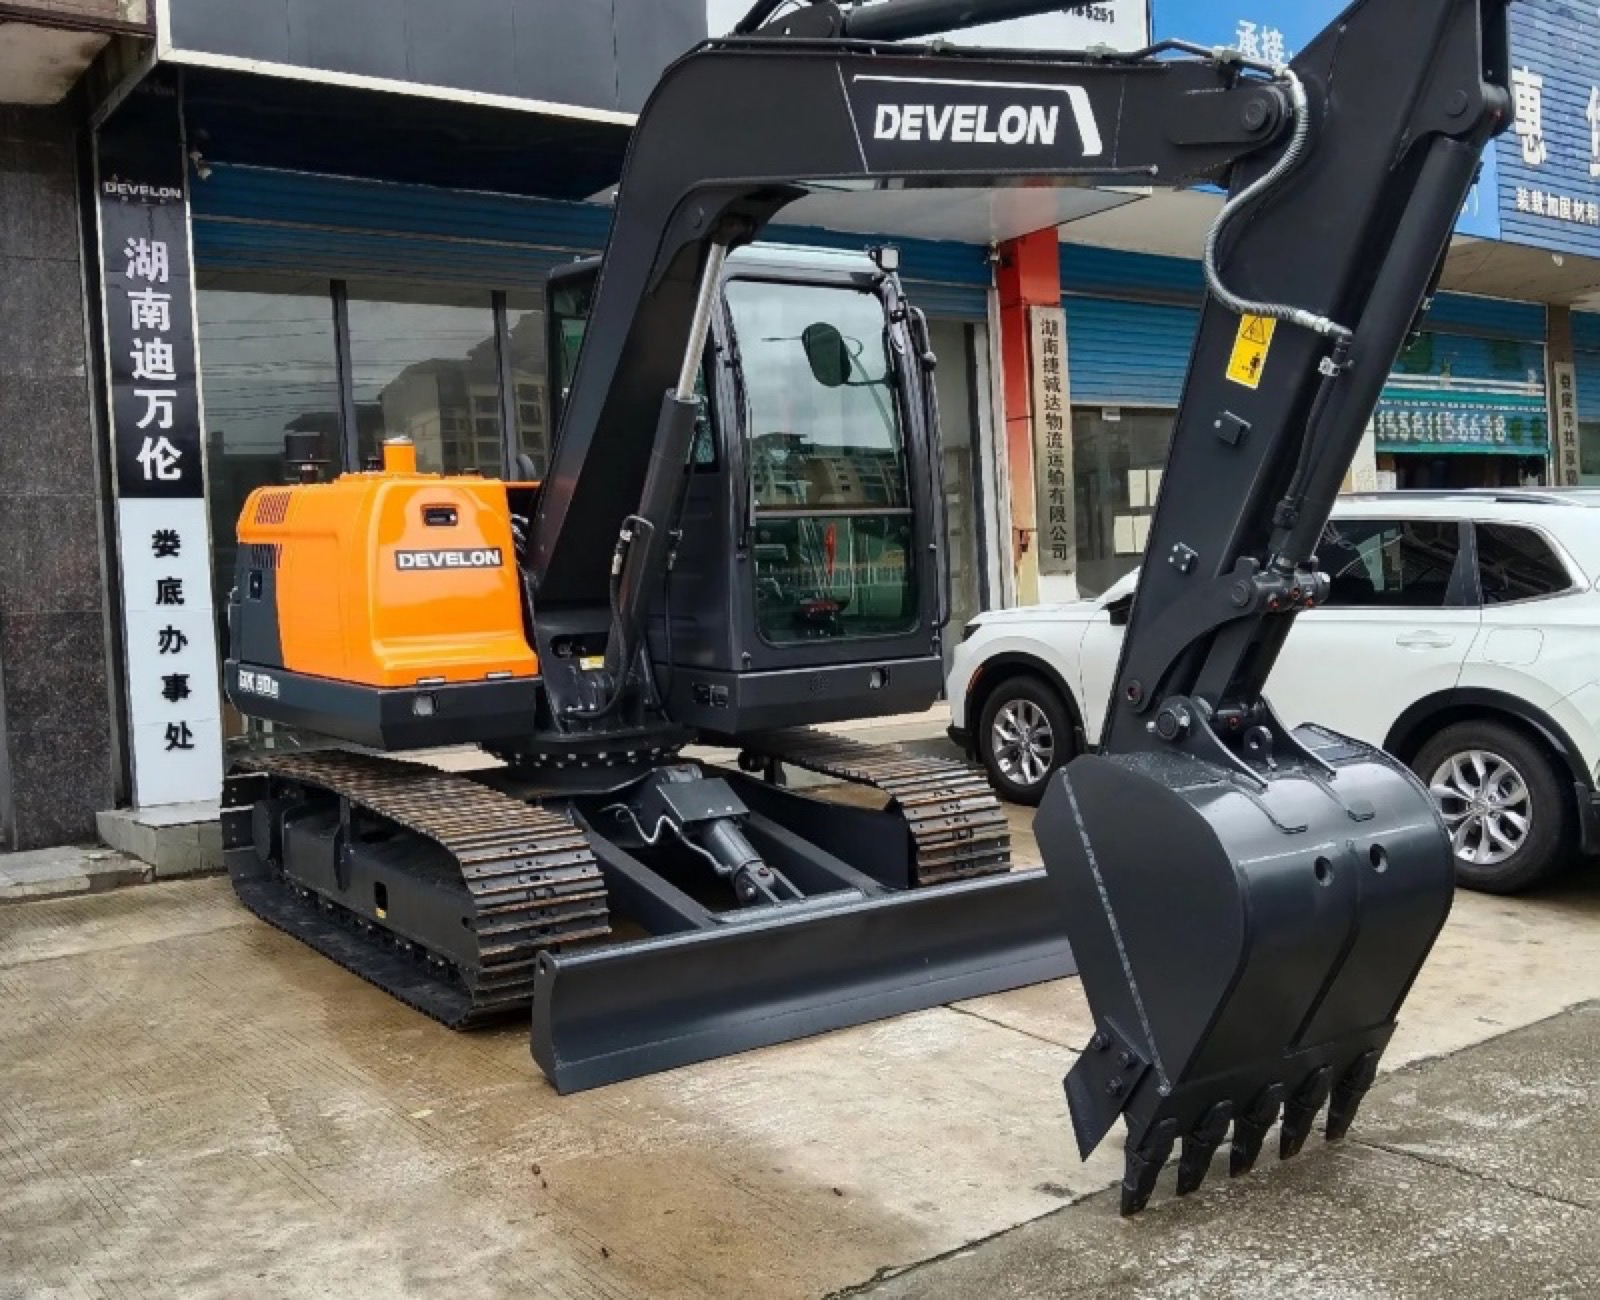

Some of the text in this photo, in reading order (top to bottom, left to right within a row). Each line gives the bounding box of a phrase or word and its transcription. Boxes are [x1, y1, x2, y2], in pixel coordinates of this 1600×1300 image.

[1236, 20, 1292, 65] 承接
[874, 104, 1059, 145] DEVELON
[103, 181, 182, 199] DEVELON
[124, 237, 182, 480] 湖南迪万伦
[398, 550, 500, 568] DEVELON
[151, 529, 194, 751] 娄底办事处
